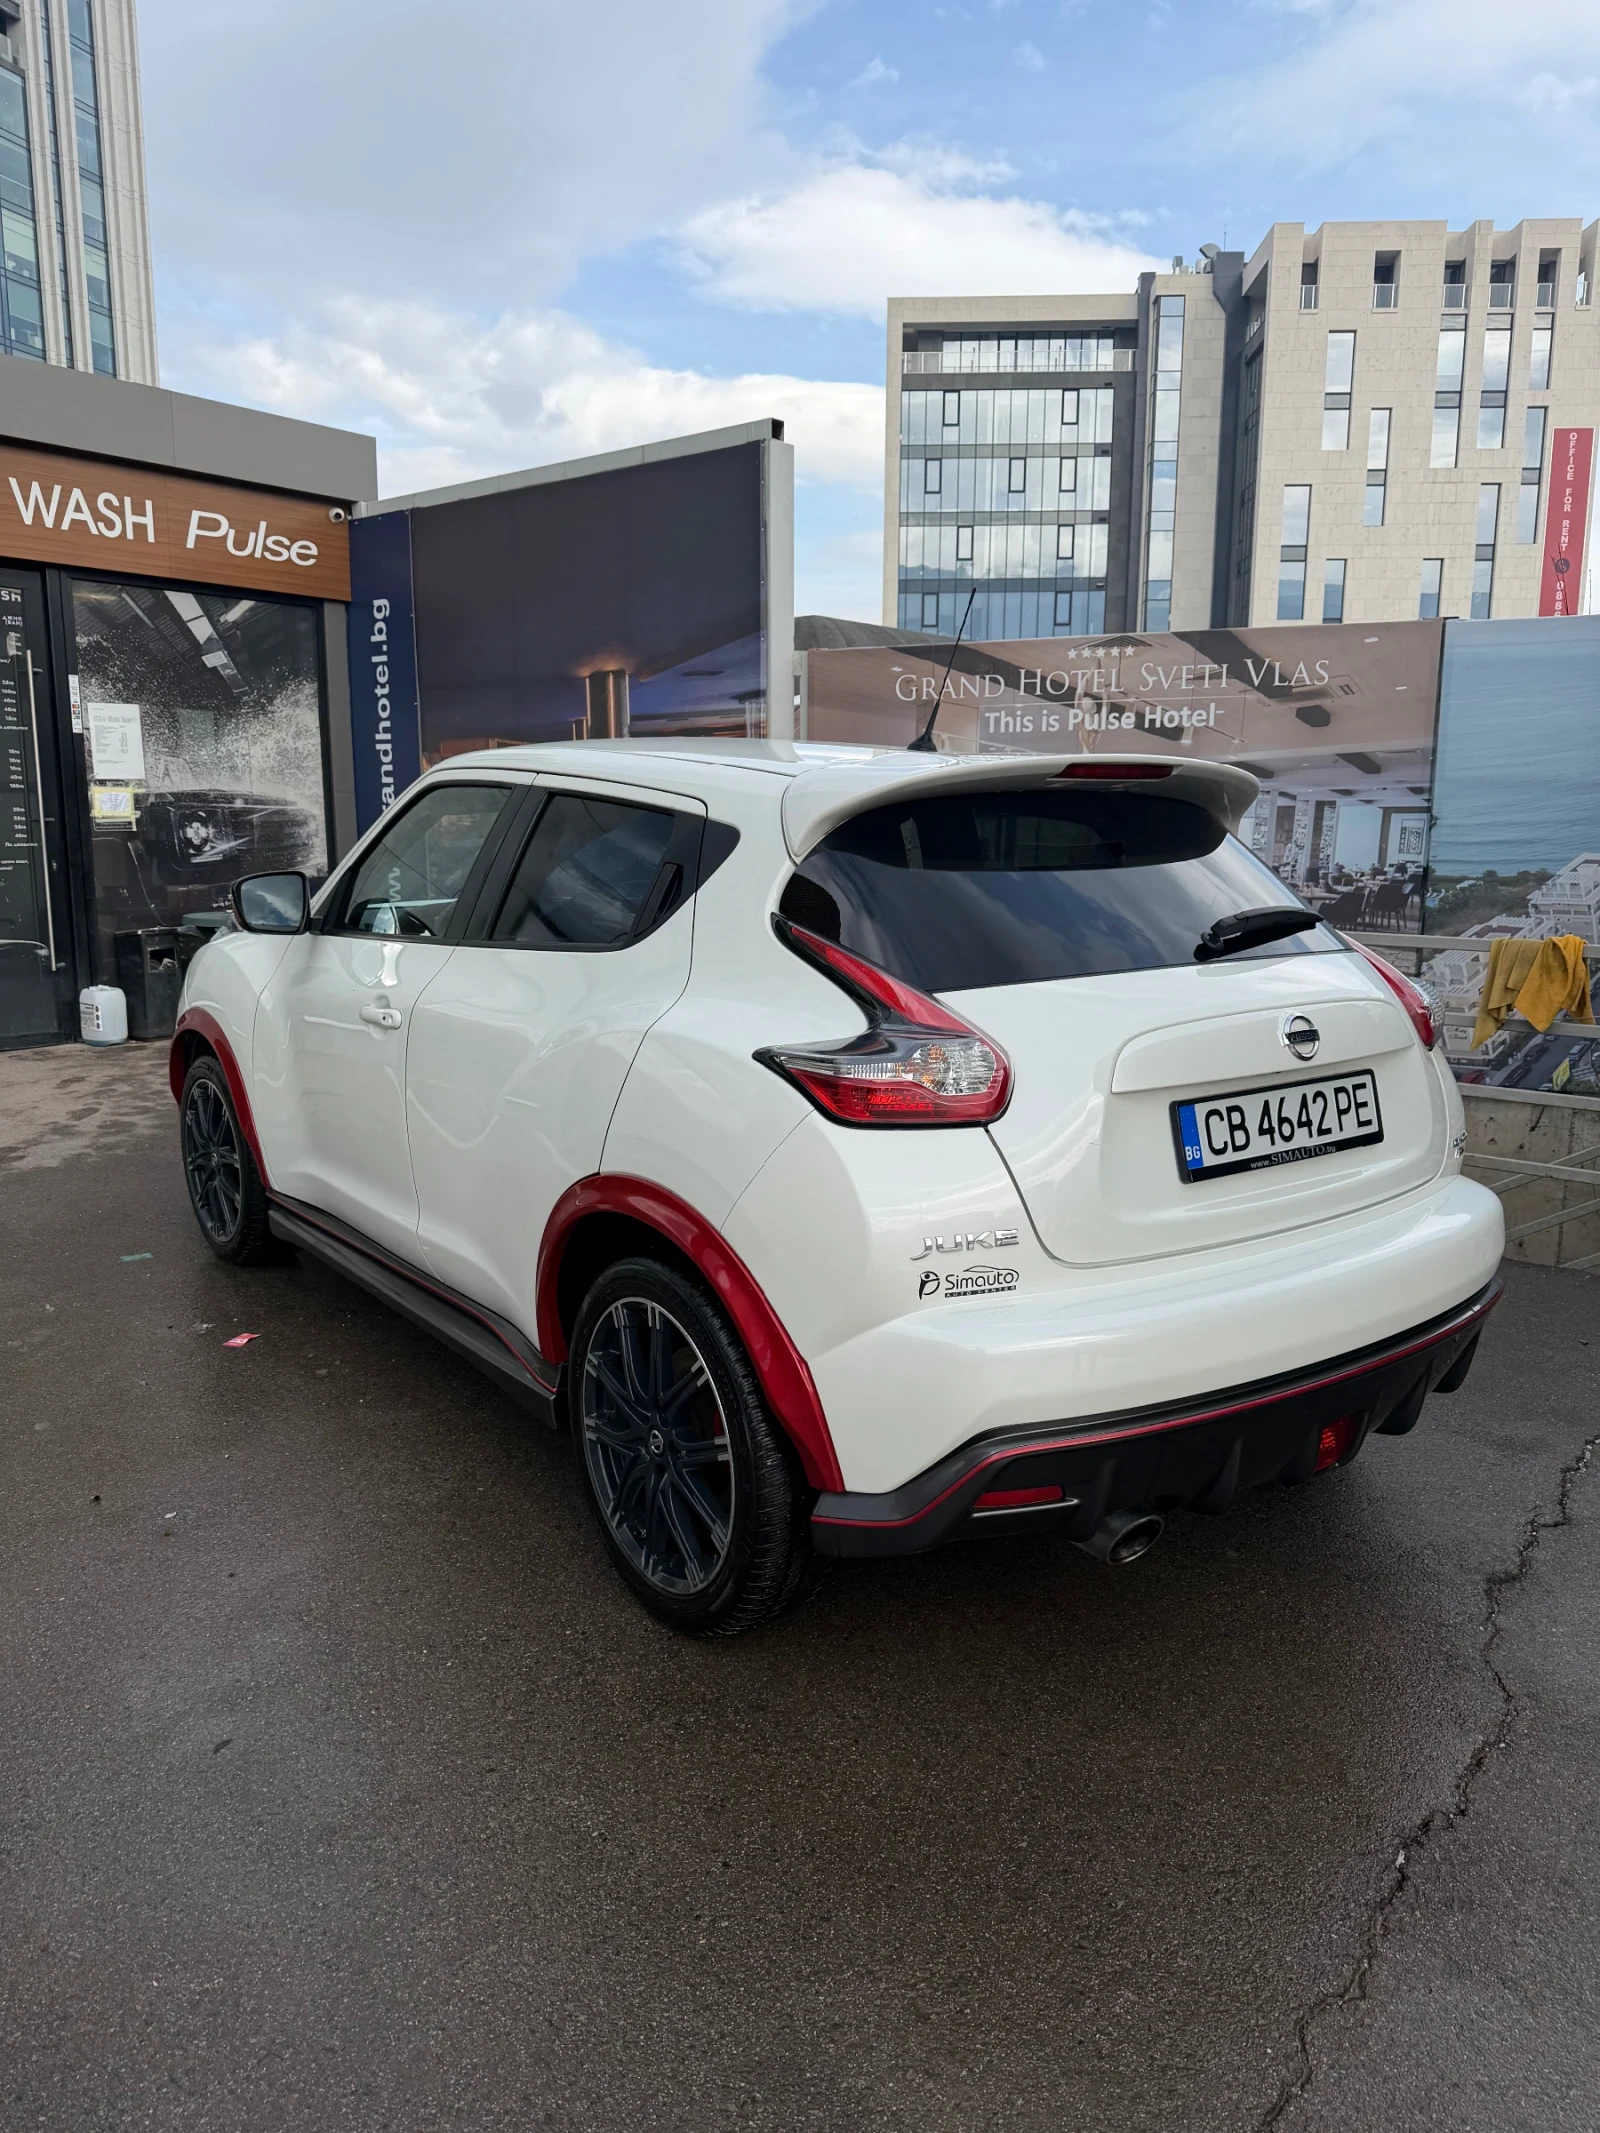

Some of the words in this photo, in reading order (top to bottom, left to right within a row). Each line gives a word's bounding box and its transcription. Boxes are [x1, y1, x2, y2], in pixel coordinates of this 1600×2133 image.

[1566, 432, 1578, 480] OFFICE
[1563, 488, 1573, 512] FOR
[8, 477, 155, 543] WASH
[186, 509, 319, 566] Pulse
[1560, 519, 1570, 552] RENT
[895, 674, 1005, 701] GRAND
[1019, 668, 1125, 696] HOTEL
[1139, 663, 1229, 692] SVETI
[1243, 657, 1330, 687] VLAS
[985, 710, 1034, 733] This
[1041, 709, 1059, 732] is
[1068, 707, 1136, 731] Pulse
[1144, 703, 1216, 728] Hotel
[1204, 1104, 1251, 1156] CB
[1258, 1090, 1333, 1146] 4642
[1332, 1082, 1373, 1132] PE
[1185, 1146, 1201, 1161] BG
[1250, 1145, 1336, 1169] www.SIMAUTO.bg
[909, 1228, 1020, 1261] JUKE
[945, 1271, 1014, 1291] Simauto
[946, 1290, 972, 1298] AUTO
